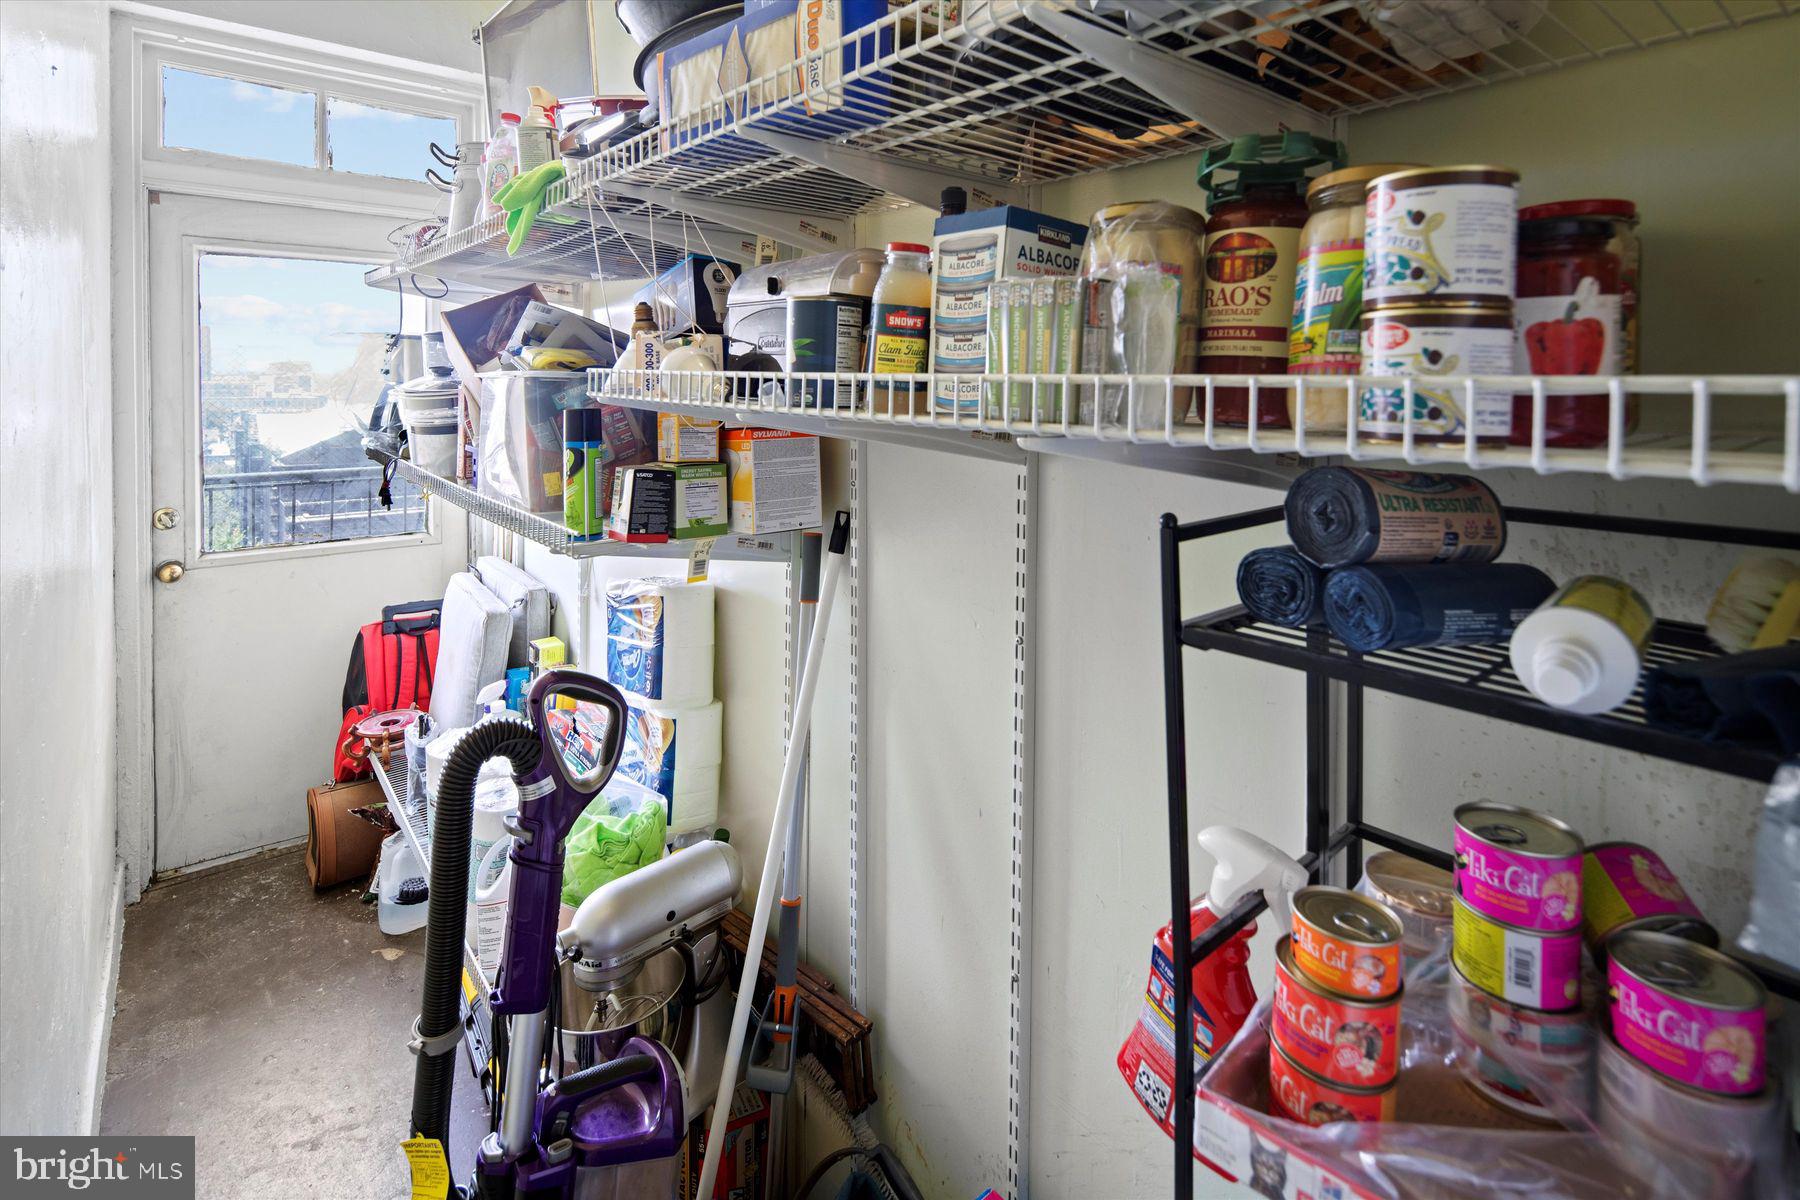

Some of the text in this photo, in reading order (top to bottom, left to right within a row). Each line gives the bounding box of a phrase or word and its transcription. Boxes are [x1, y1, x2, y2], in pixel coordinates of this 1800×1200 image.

[1040, 227, 1071, 243] KIRKLAND
[948, 258, 985, 270] ALBACORE
[1016, 262, 1041, 274] SOLID
[1205, 286, 1272, 308] RAO'S
[946, 301, 982, 311] ALBACORE
[888, 315, 922, 327] SNOW'S
[1207, 329, 1257, 338] MARINARA
[878, 343, 901, 355] Clam
[945, 342, 982, 352] ALBACORE
[752, 430, 791, 438] SYLVANIA
[1378, 493, 1482, 513] ULTRA RESISTANT
